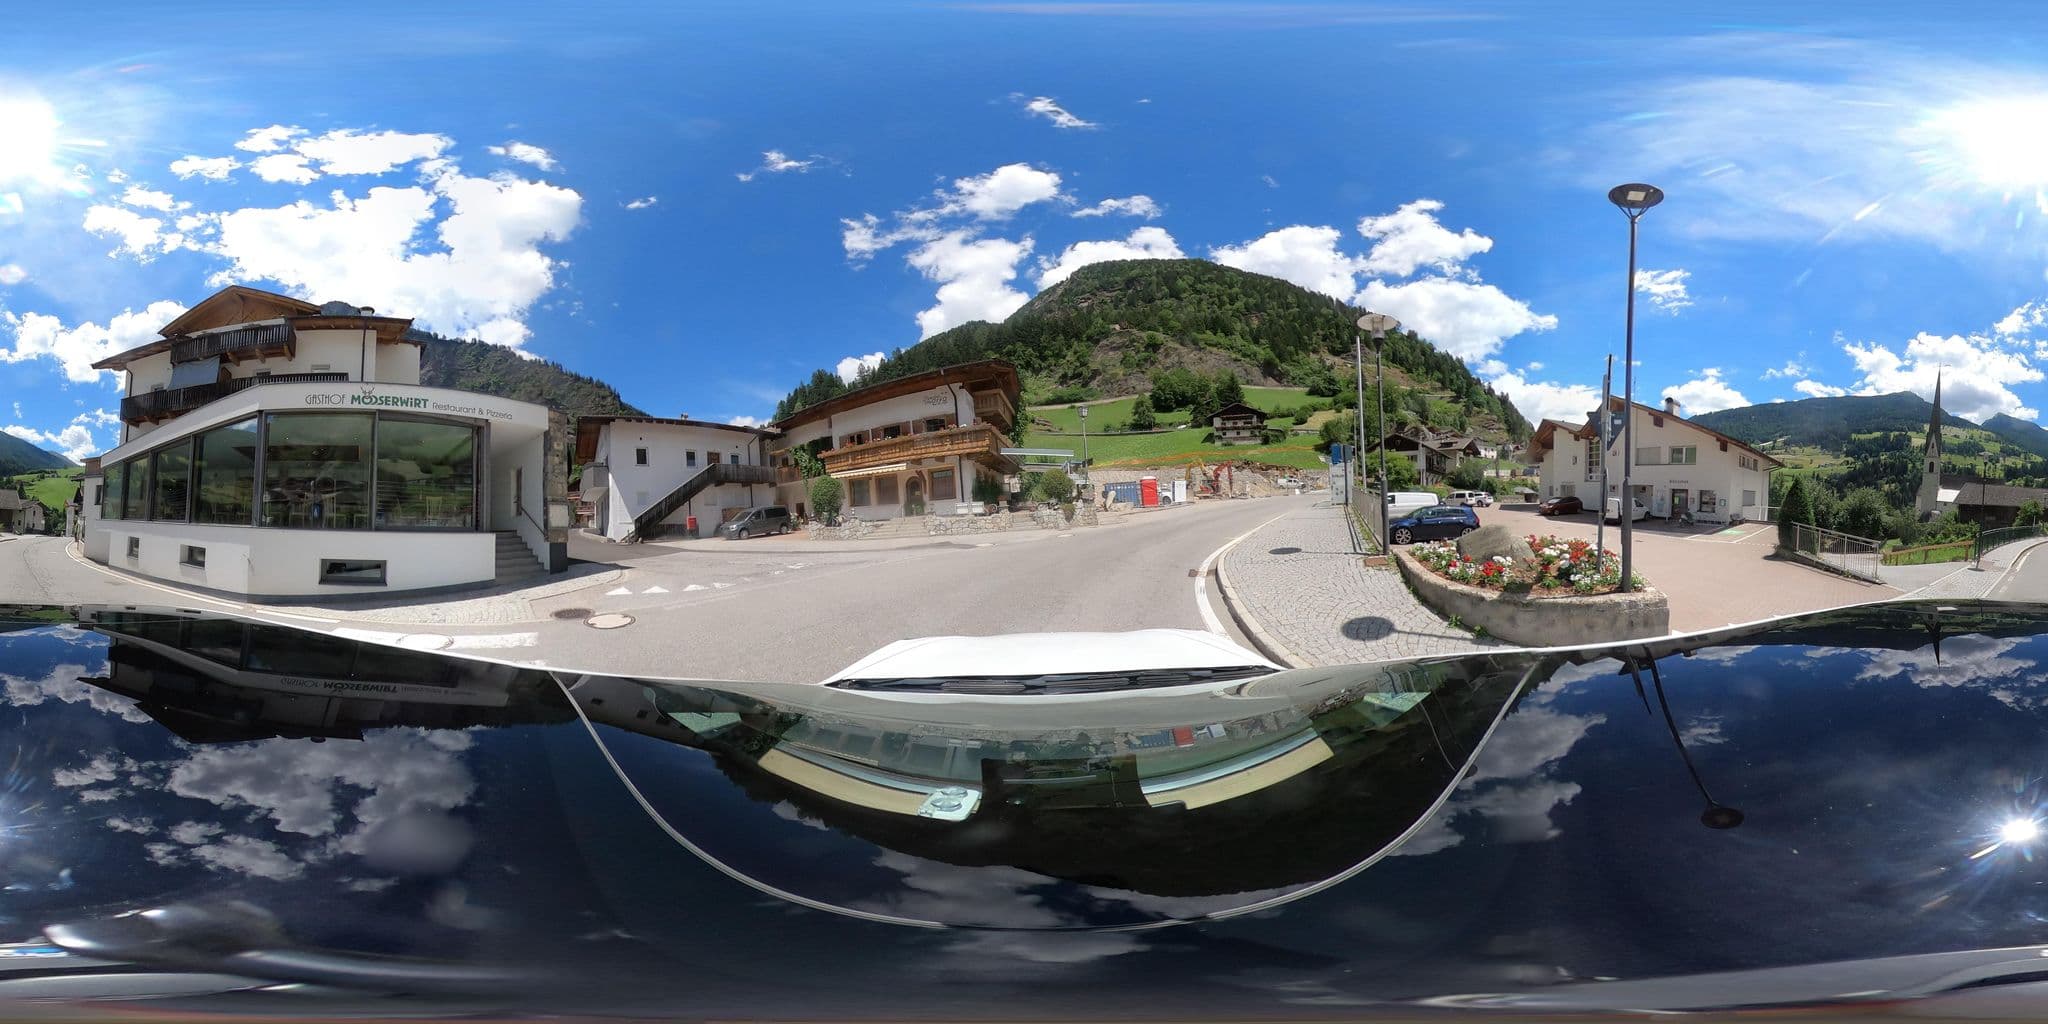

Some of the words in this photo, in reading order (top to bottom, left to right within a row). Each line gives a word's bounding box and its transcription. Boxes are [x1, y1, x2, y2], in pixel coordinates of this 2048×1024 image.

[305, 393, 345, 405] GASTHOF
[432, 402, 476, 415] Restaurant
[478, 407, 484, 416] &
